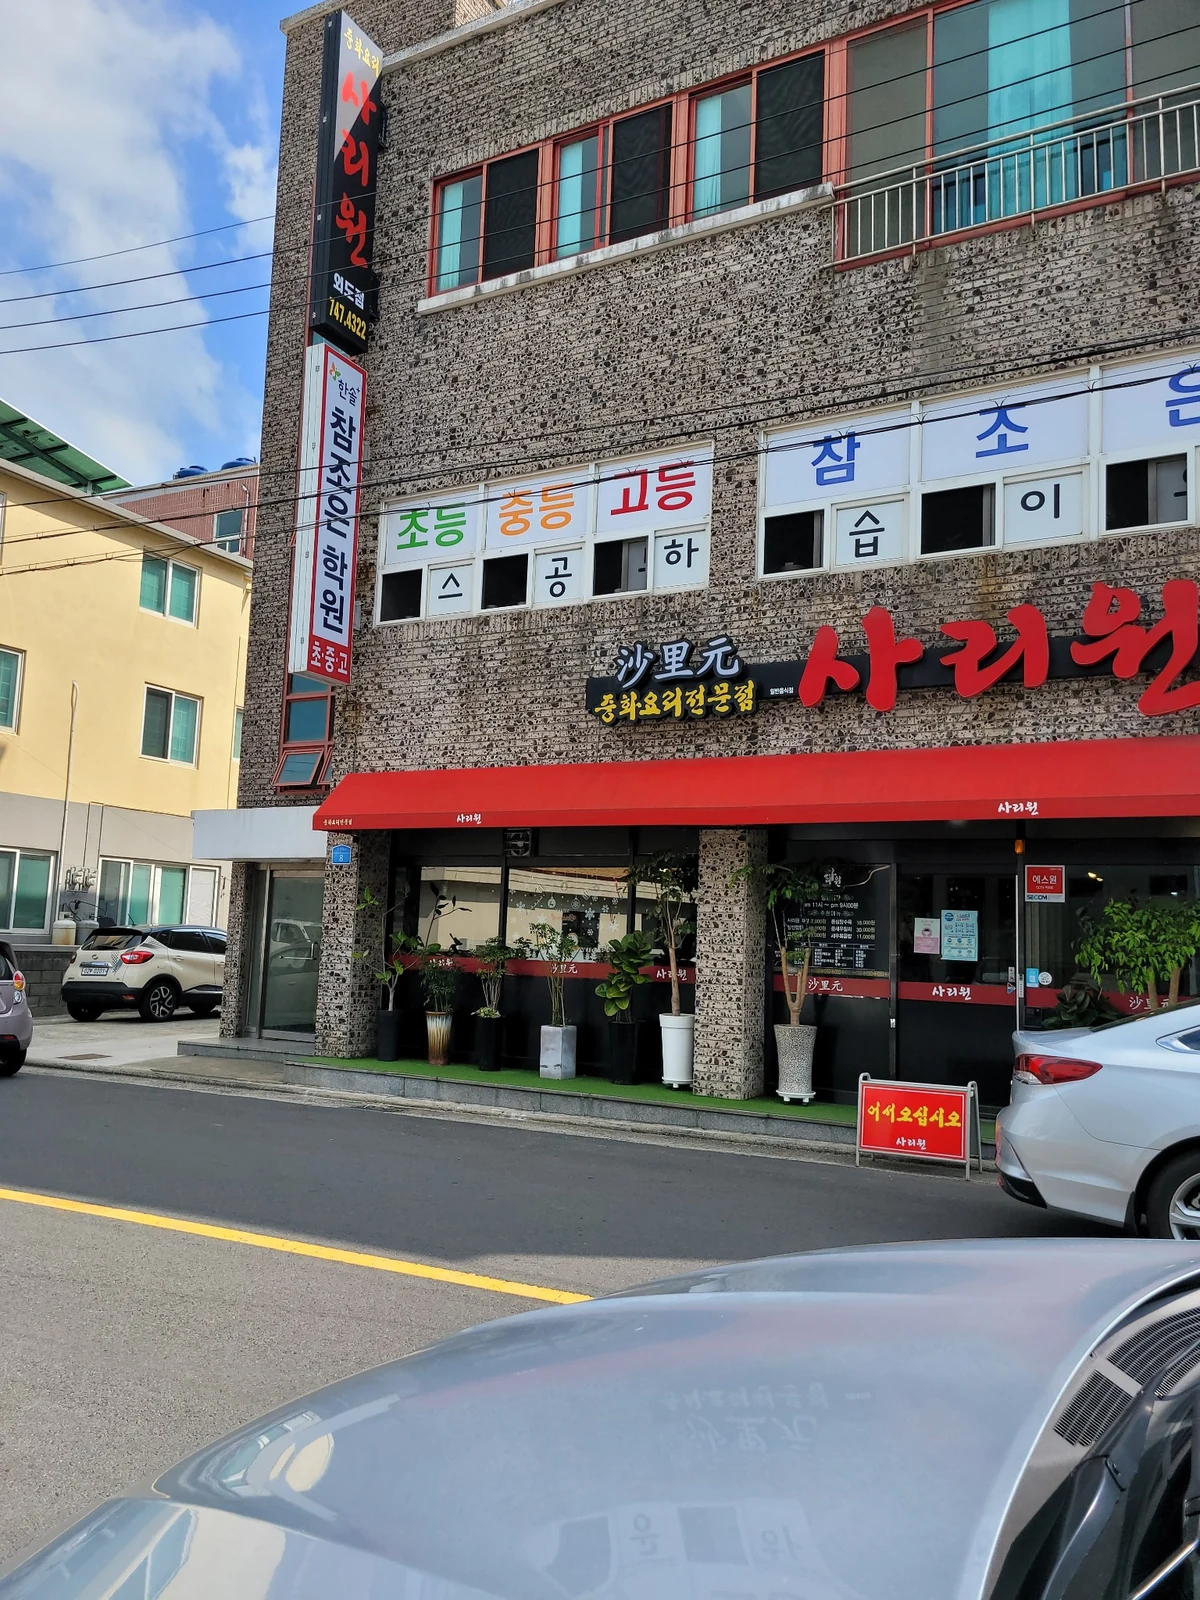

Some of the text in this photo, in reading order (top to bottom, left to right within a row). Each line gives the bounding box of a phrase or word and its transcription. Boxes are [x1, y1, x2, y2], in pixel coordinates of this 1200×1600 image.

[335, 70, 377, 268] 사리원
[332, 272, 365, 310] 외도점
[397, 460, 696, 550] 초등 중등 고등
[799, 579, 1200, 716] 사리원
[616, 637, 740, 689] 沙里元
[594, 679, 755, 723] 중화요리전문점
[456, 812, 482, 825] 사리원
[997, 801, 1039, 816] 사리원
[338, 854, 344, 862] 8
[1032, 874, 1057, 885] 에스원
[808, 977, 844, 991] 沙里元
[931, 985, 972, 1001] 사리원
[866, 1100, 962, 1128] 어서오십시오
[895, 1136, 927, 1150] 사리원
